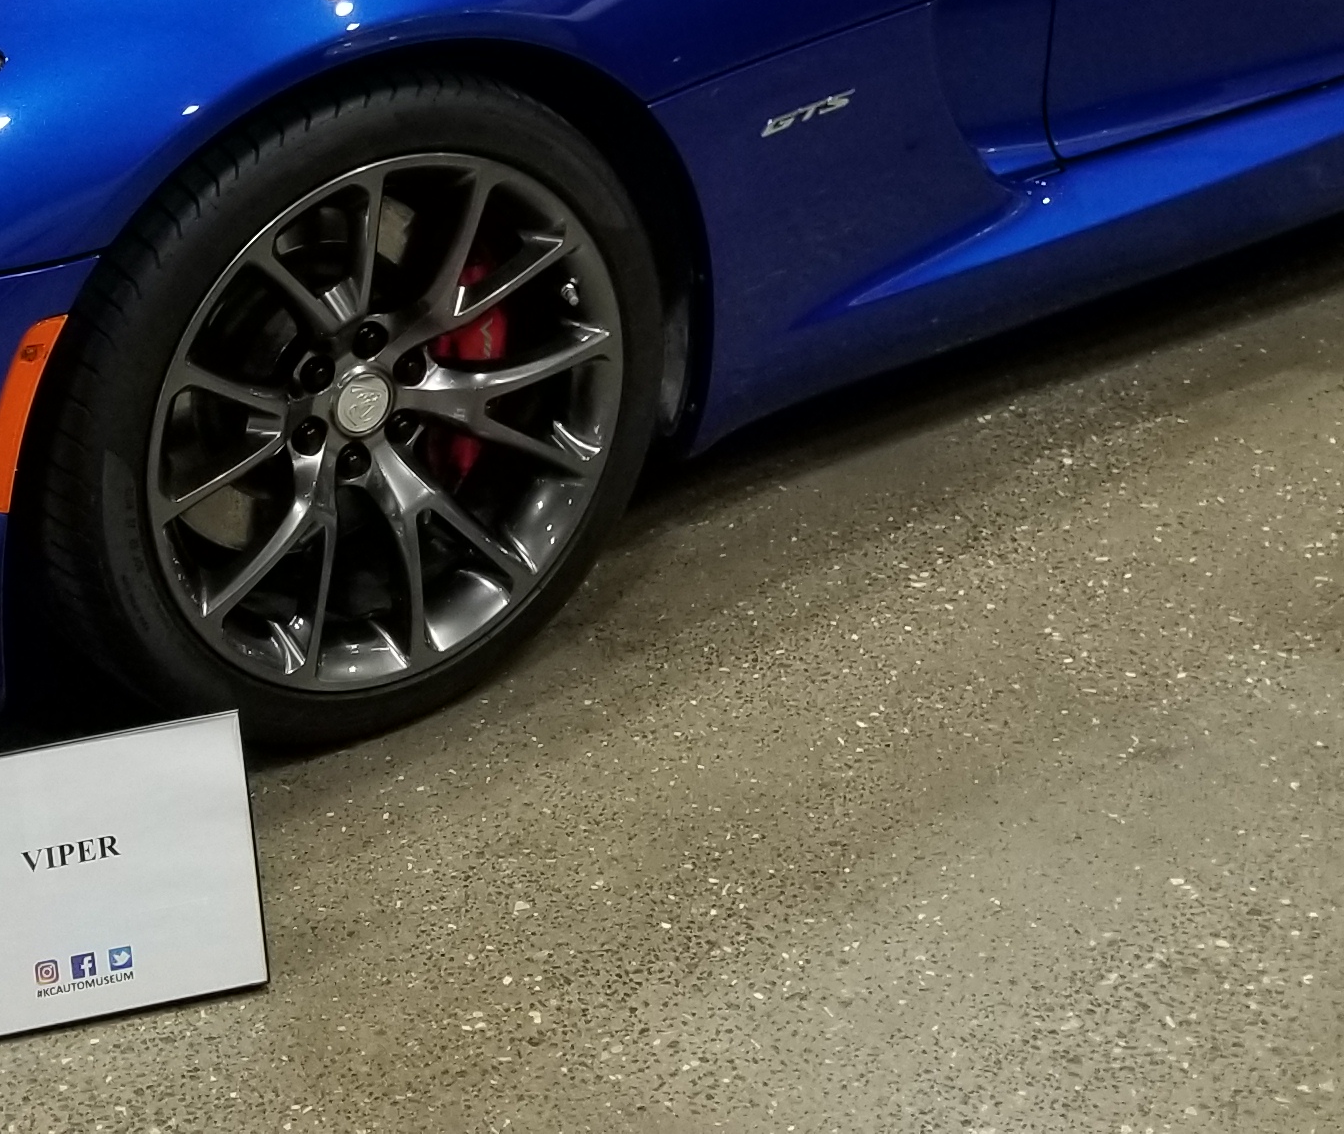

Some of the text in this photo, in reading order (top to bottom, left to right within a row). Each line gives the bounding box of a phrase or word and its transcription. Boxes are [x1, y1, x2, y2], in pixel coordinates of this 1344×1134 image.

[760, 88, 856, 138] GTS
[20, 835, 122, 873] VIPER
[36, 971, 135, 998] #KCAUTOMUSEUM
